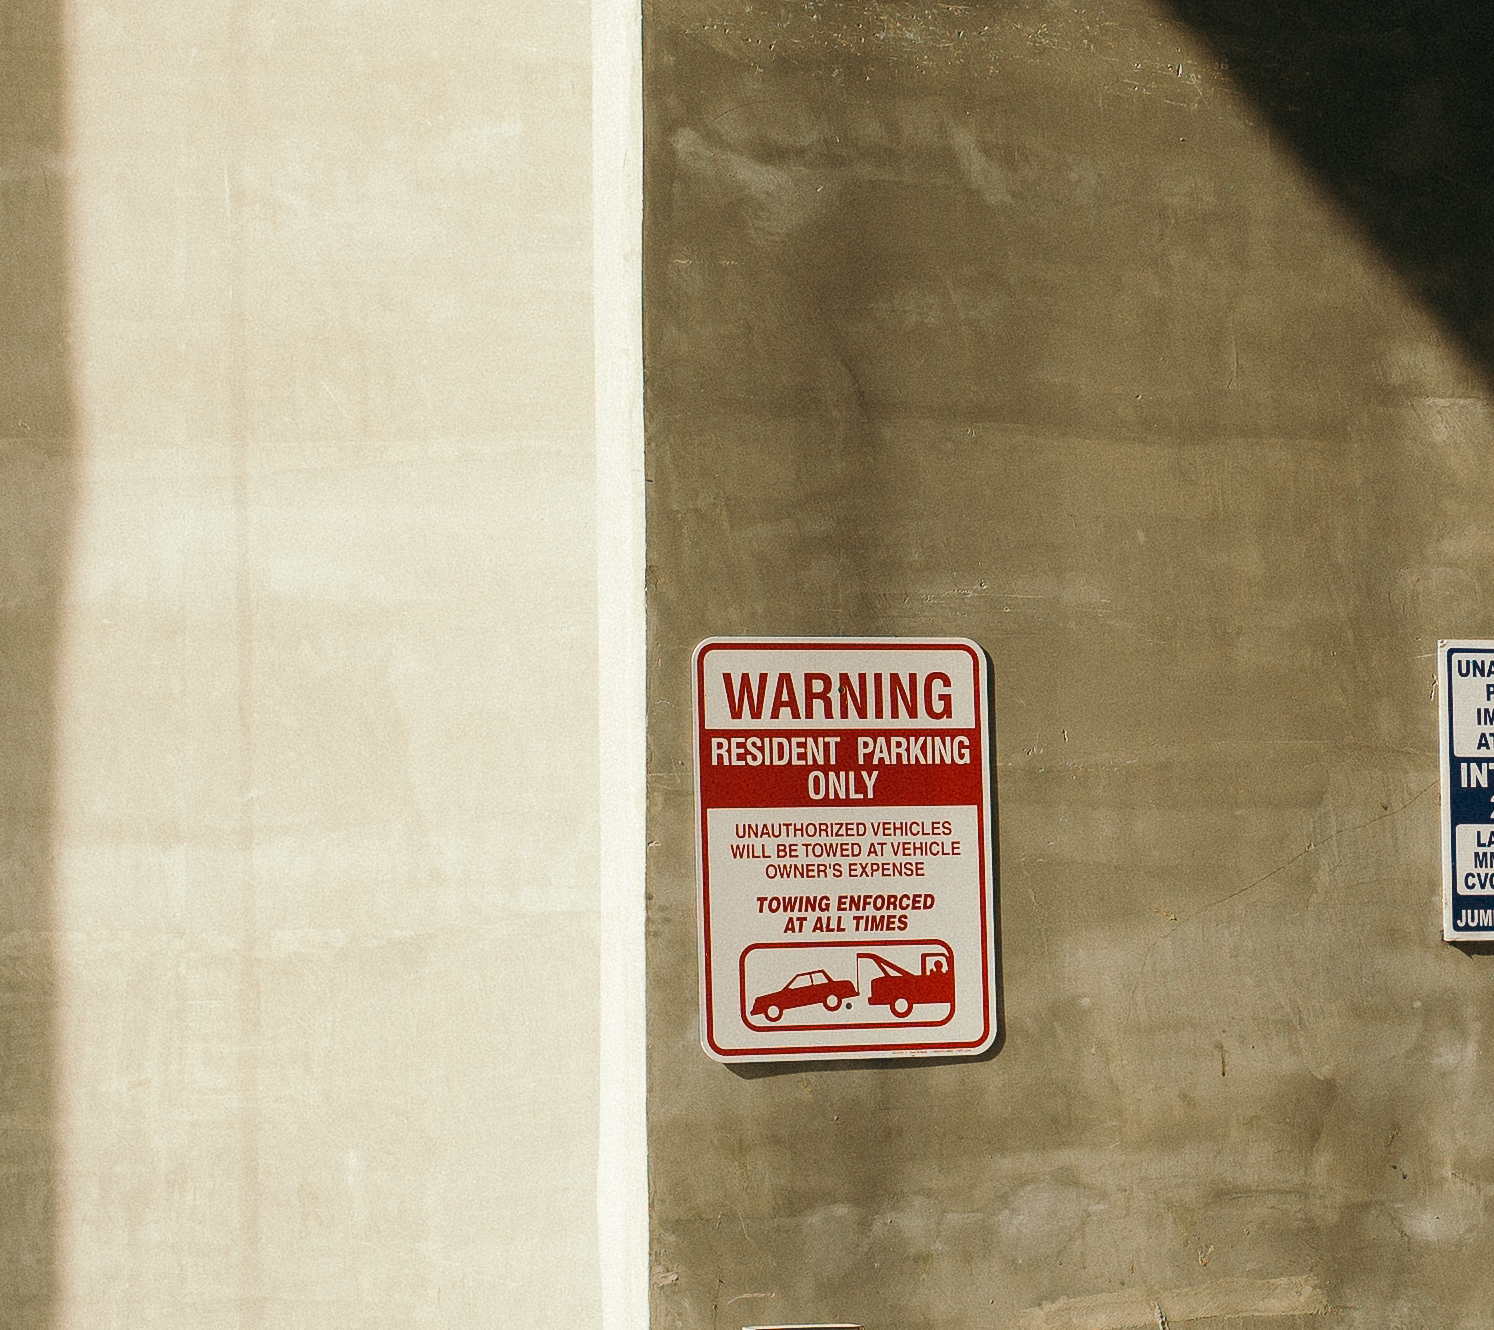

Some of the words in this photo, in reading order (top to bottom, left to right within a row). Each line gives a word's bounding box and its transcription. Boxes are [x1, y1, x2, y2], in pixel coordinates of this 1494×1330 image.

[723, 672, 952, 720] WARNING
[712, 737, 840, 766] RESIDENT
[858, 736, 970, 764] PARKING
[808, 771, 878, 799] ONLY
[736, 822, 866, 838] UNAUTHORIZED
[871, 821, 952, 836] VEHICLES
[731, 844, 771, 859] WILL
[777, 844, 798, 858] BE
[802, 843, 861, 858] TOWED
[867, 843, 887, 857] AT
[891, 841, 961, 856] VEHICLE
[766, 863, 842, 879] OWNER'S
[849, 862, 924, 877] EXPENSE
[757, 895, 830, 913] TOWING
[837, 894, 935, 911] ENFORCED
[784, 917, 807, 933] AT
[812, 916, 845, 932] ALL
[853, 914, 908, 931] TIMES
